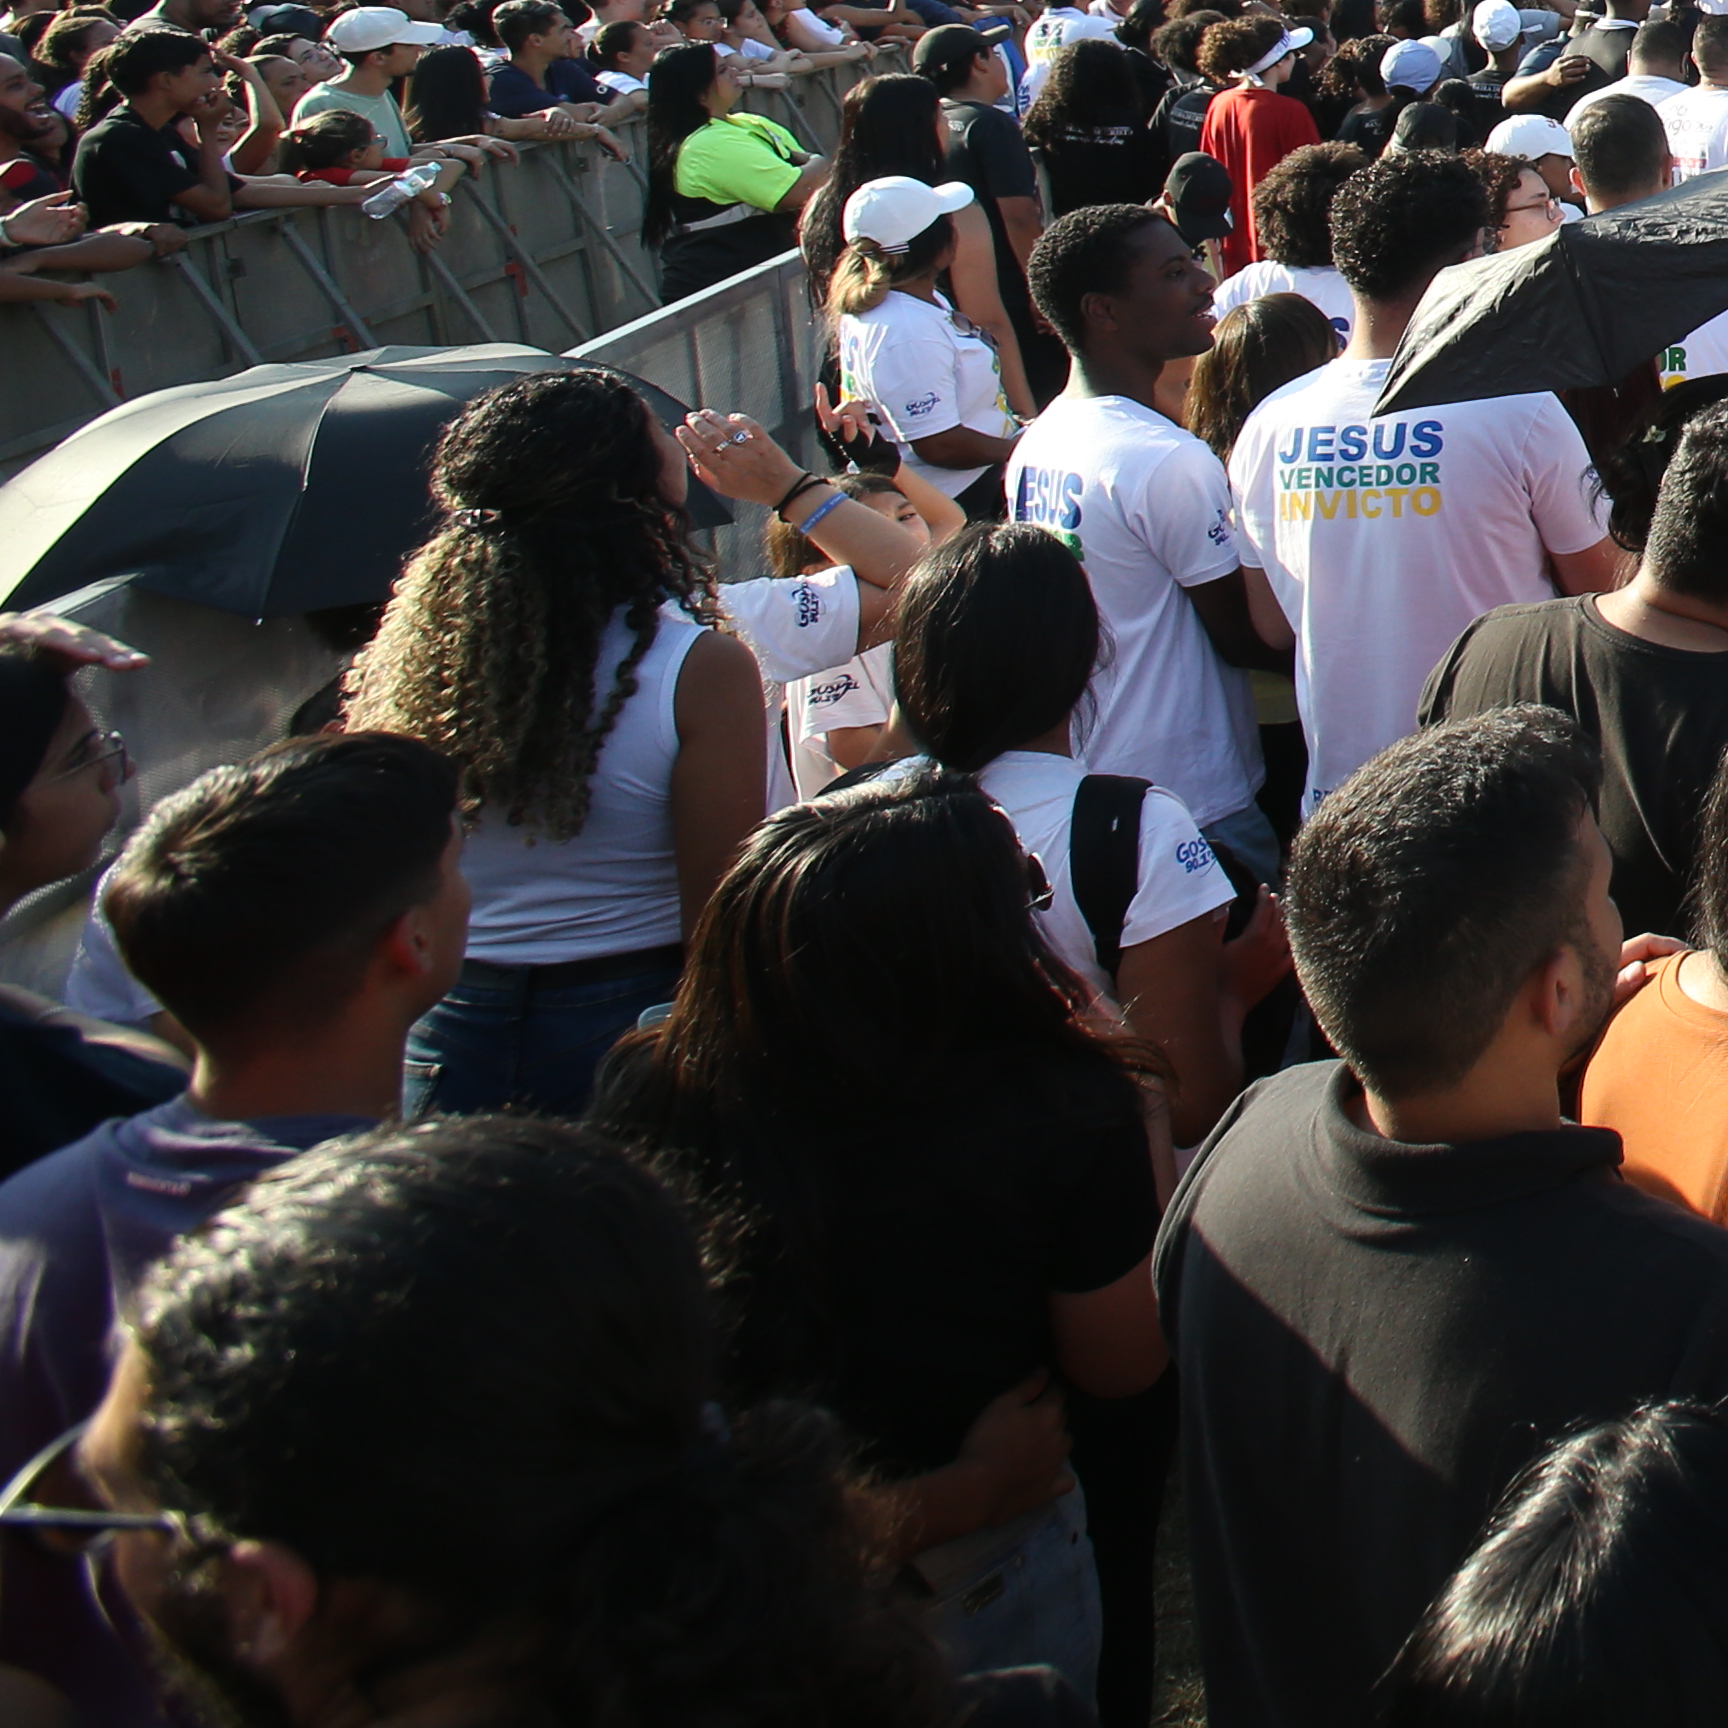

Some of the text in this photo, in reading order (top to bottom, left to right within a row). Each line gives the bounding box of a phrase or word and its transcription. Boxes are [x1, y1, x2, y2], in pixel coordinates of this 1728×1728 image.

[1279, 420, 1444, 465] JESUS
[1280, 462, 1441, 490] VENCEDOR
[1279, 486, 1442, 523] INVICTO
